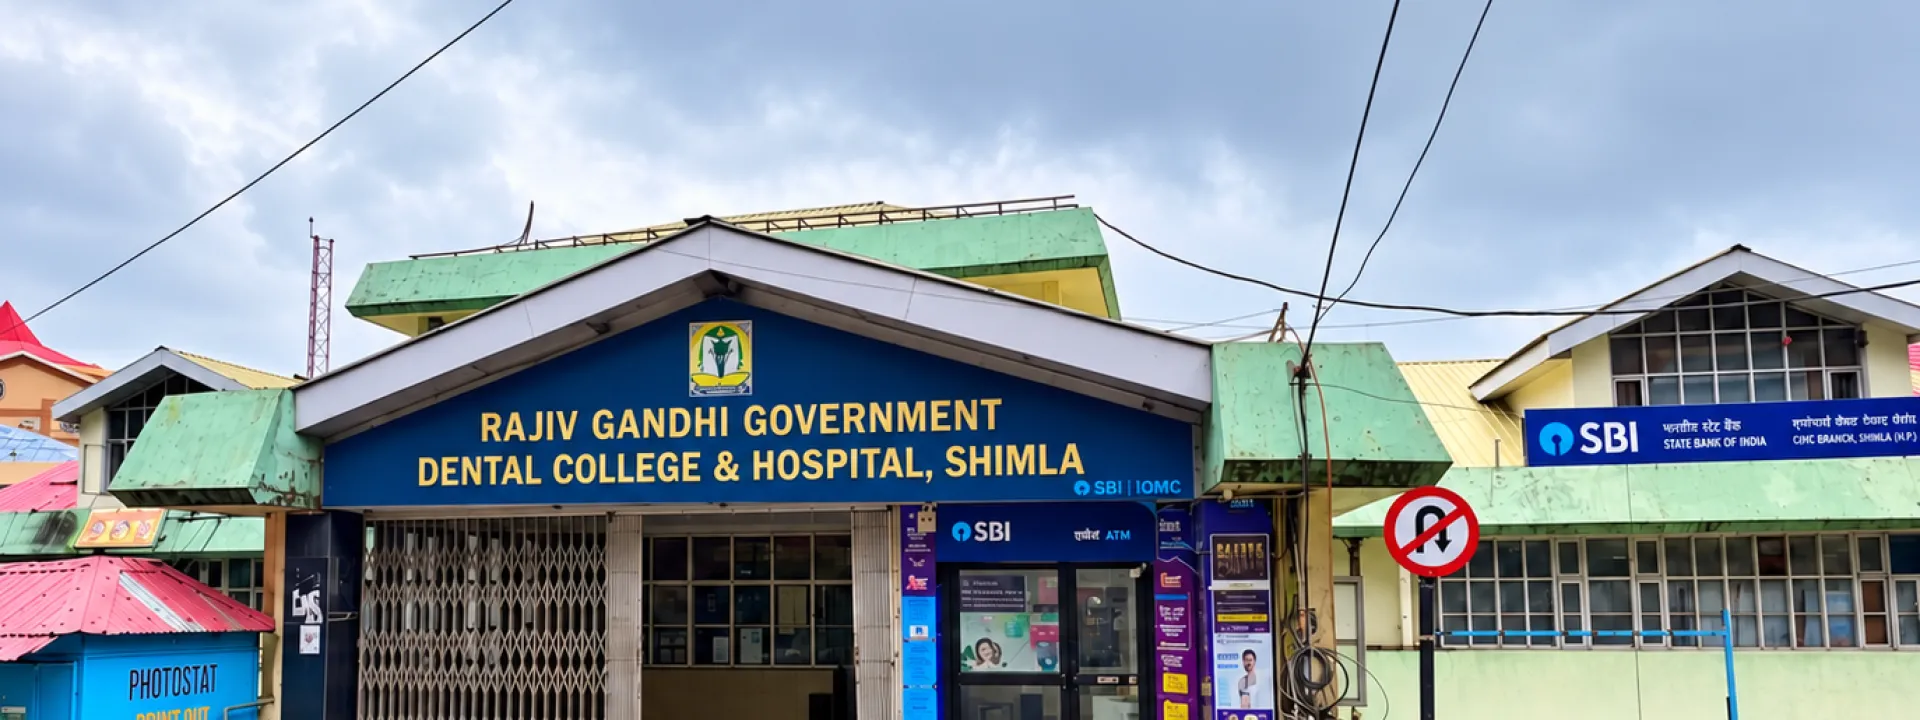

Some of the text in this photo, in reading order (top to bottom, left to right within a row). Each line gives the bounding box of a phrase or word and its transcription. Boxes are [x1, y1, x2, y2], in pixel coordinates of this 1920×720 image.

[481, 398, 1002, 442] RAJIV GANDHI GOVERNMENT
[1579, 421, 1639, 454] SBI
[1663, 436, 1767, 450] STATE BANK OF INDIA
[418, 443, 1085, 486] DENTAL COLLEGE & HOSPITAL, SHIMLA
[1094, 480, 1122, 495] SBI
[974, 521, 1010, 541] SBI
[1105, 529, 1131, 541] ATM
[129, 664, 218, 700] PHOTOSTAT
